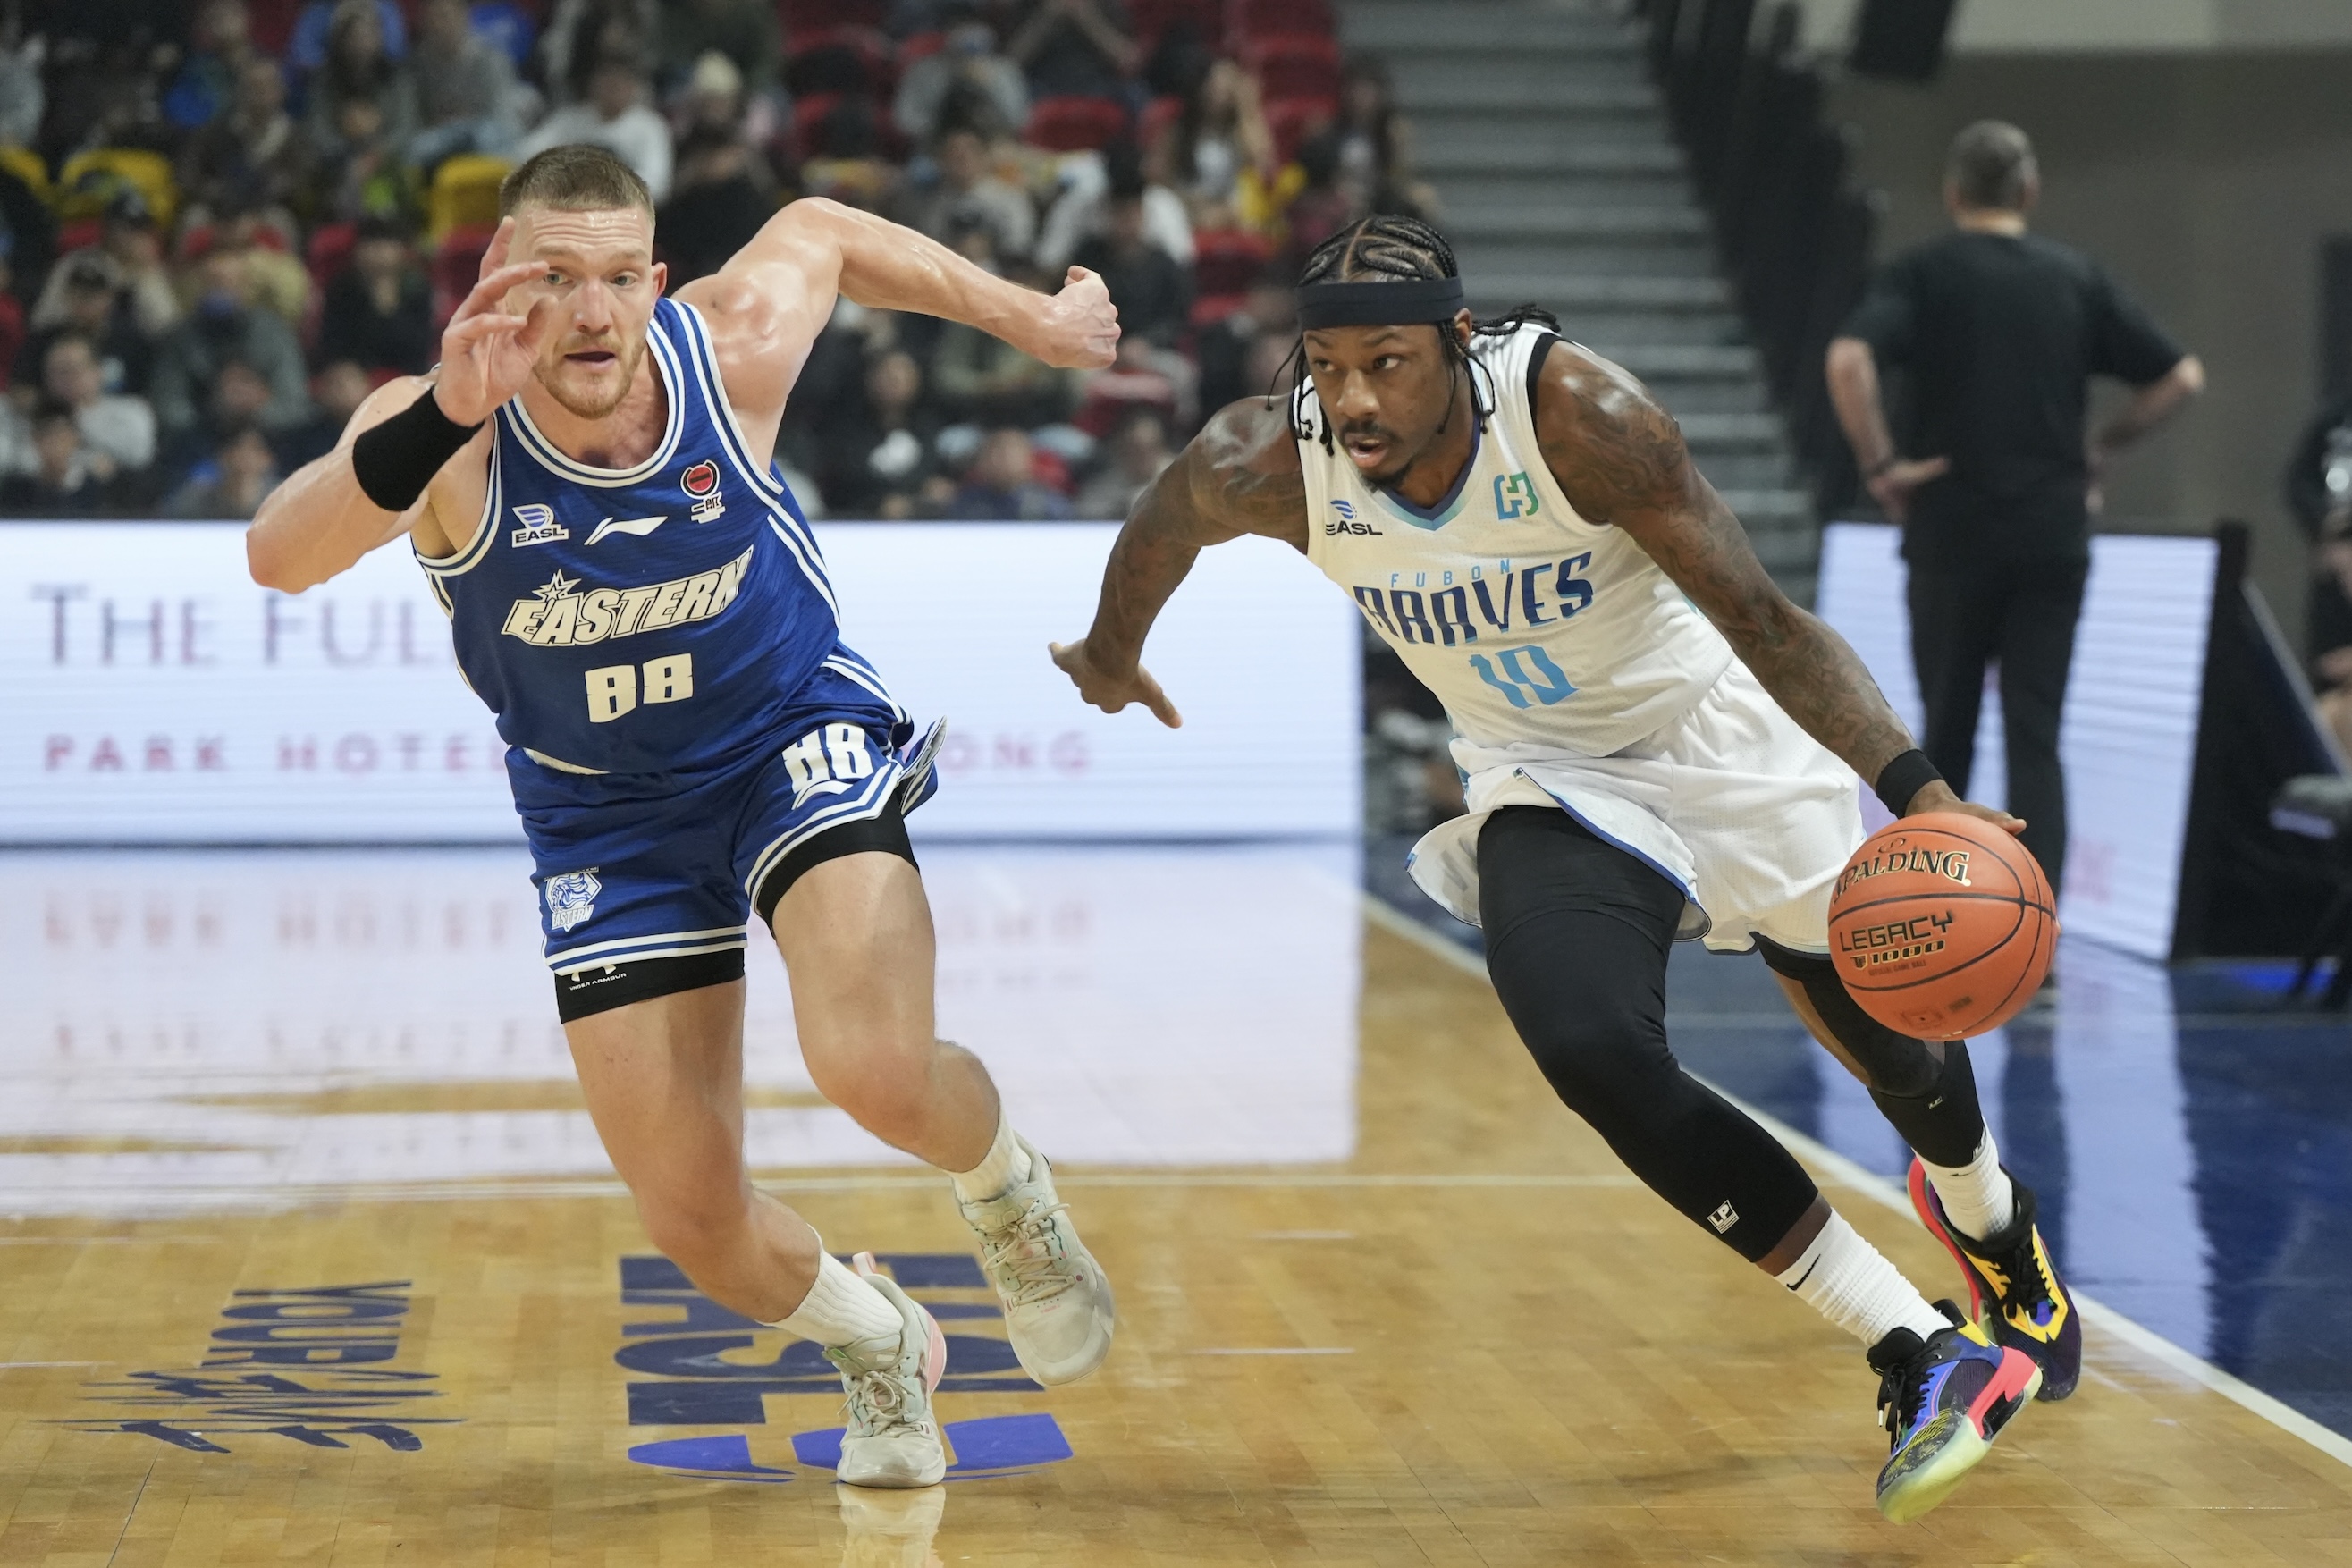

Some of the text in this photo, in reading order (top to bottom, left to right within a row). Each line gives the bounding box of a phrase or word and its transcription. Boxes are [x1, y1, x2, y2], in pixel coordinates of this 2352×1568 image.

[515, 527, 565, 544] EASL
[1326, 520, 1383, 535] EASL
[1390, 559, 1511, 587] FUBON
[502, 545, 754, 646] EASTERN
[29, 583, 217, 667] THE
[585, 653, 694, 723] 88
[1469, 645, 1580, 709] 10
[44, 734, 226, 772] PARK
[901, 731, 1092, 775] ONG
[552, 906, 593, 927] EASTERN
[1840, 910, 1952, 952] LEGACY
[569, 973, 627, 991] UNDER ARMOUR
[1709, 1204, 1731, 1227] LP
[200, 1279, 412, 1367] YOUR
